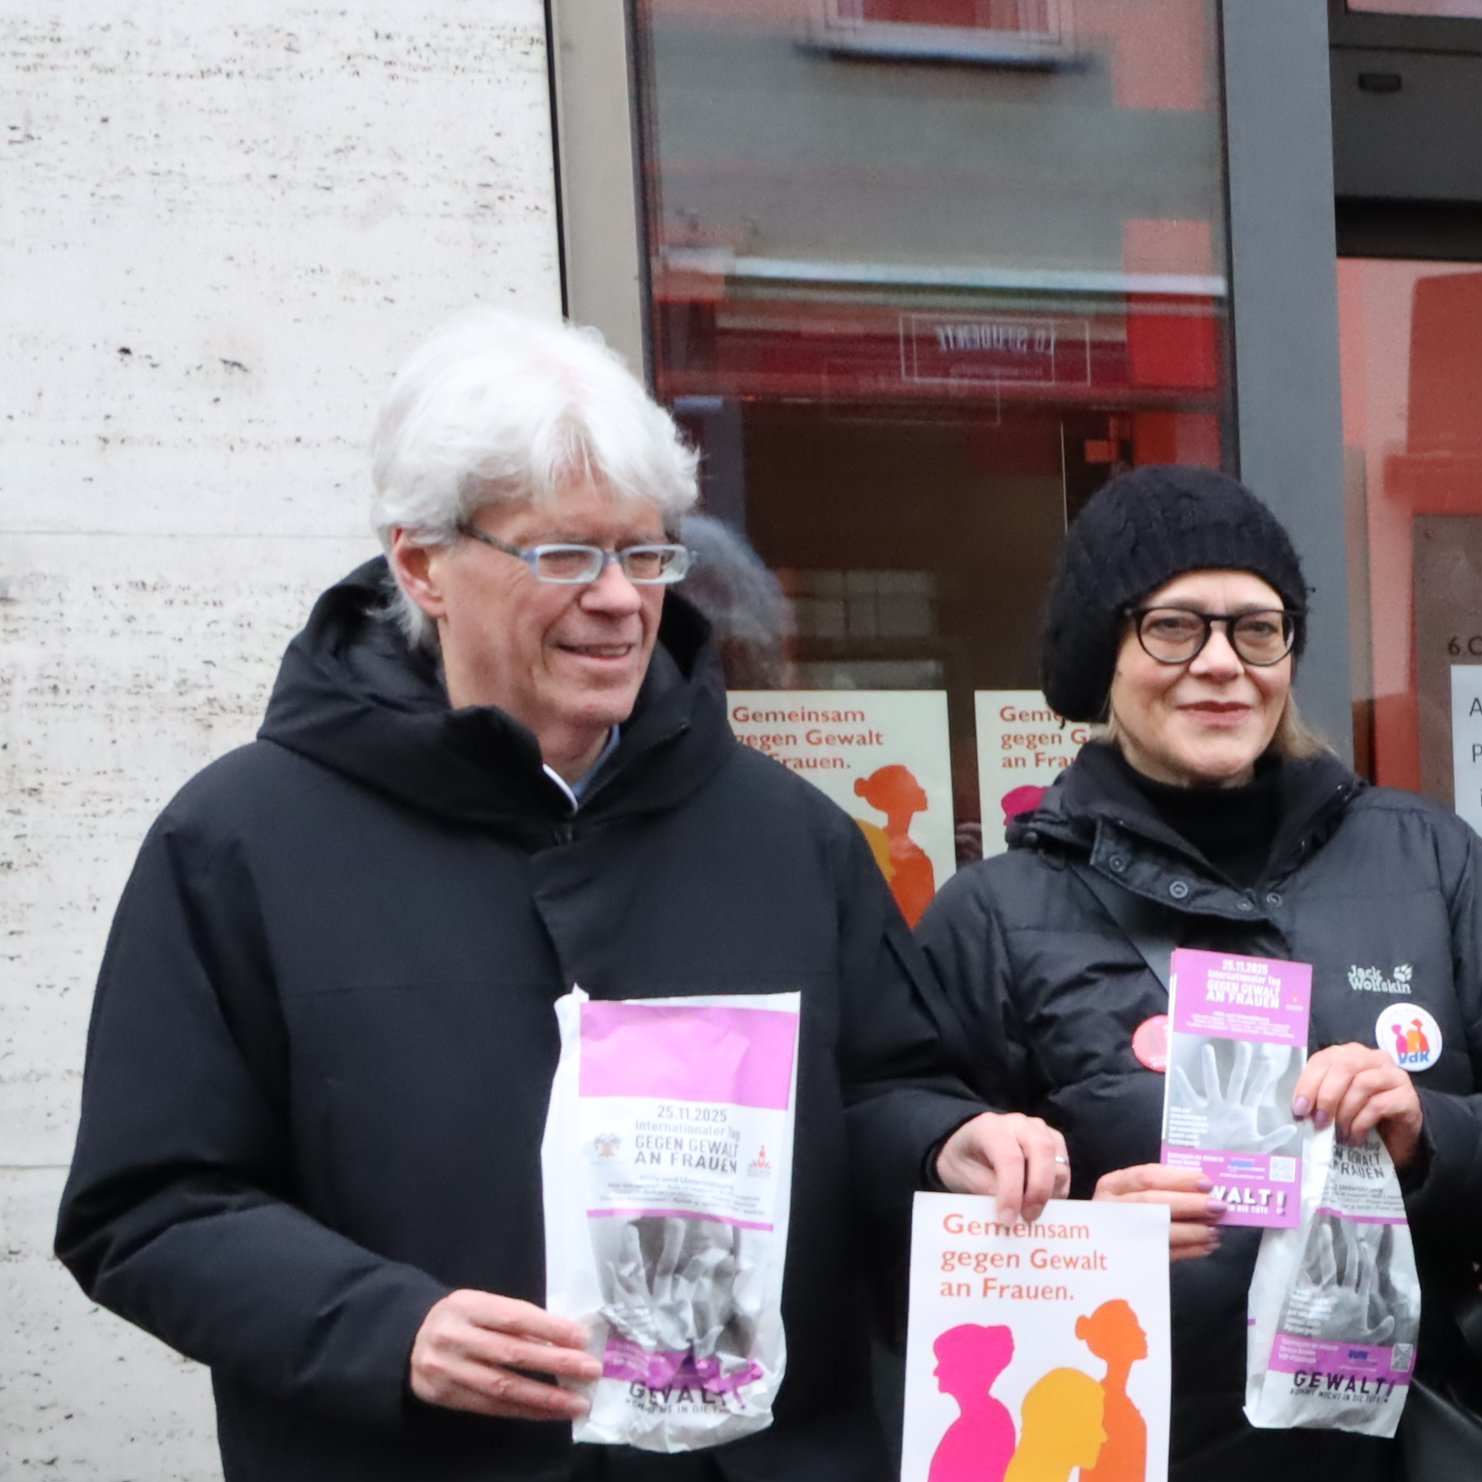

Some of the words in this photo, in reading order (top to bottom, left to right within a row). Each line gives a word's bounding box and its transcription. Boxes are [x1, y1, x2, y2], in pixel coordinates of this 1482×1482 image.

[732, 706, 865, 723] Gemeinsam
[805, 729, 884, 746] Gewalt
[1001, 733, 1062, 750] gegen
[1002, 756, 1026, 768] an
[1348, 965, 1383, 981] Jack
[1348, 978, 1412, 995] Wolfskin
[1206, 989, 1225, 1003] AN
[1228, 993, 1280, 1009] FRAUEN
[657, 1104, 728, 1122] 25.11.2025
[635, 1119, 725, 1137] Internationaler
[728, 1126, 741, 1141] Tag
[635, 1135, 684, 1151] GEGEN
[689, 1138, 740, 1158] GEWALT
[635, 1151, 662, 1165] AN
[671, 1152, 737, 1174] FRAUEN
[943, 1213, 1090, 1240] Gemeinsam
[941, 1250, 1020, 1273] gegen
[1030, 1249, 1108, 1271] Gewalt
[939, 1280, 971, 1298] an
[982, 1277, 1075, 1301] Frauen.
